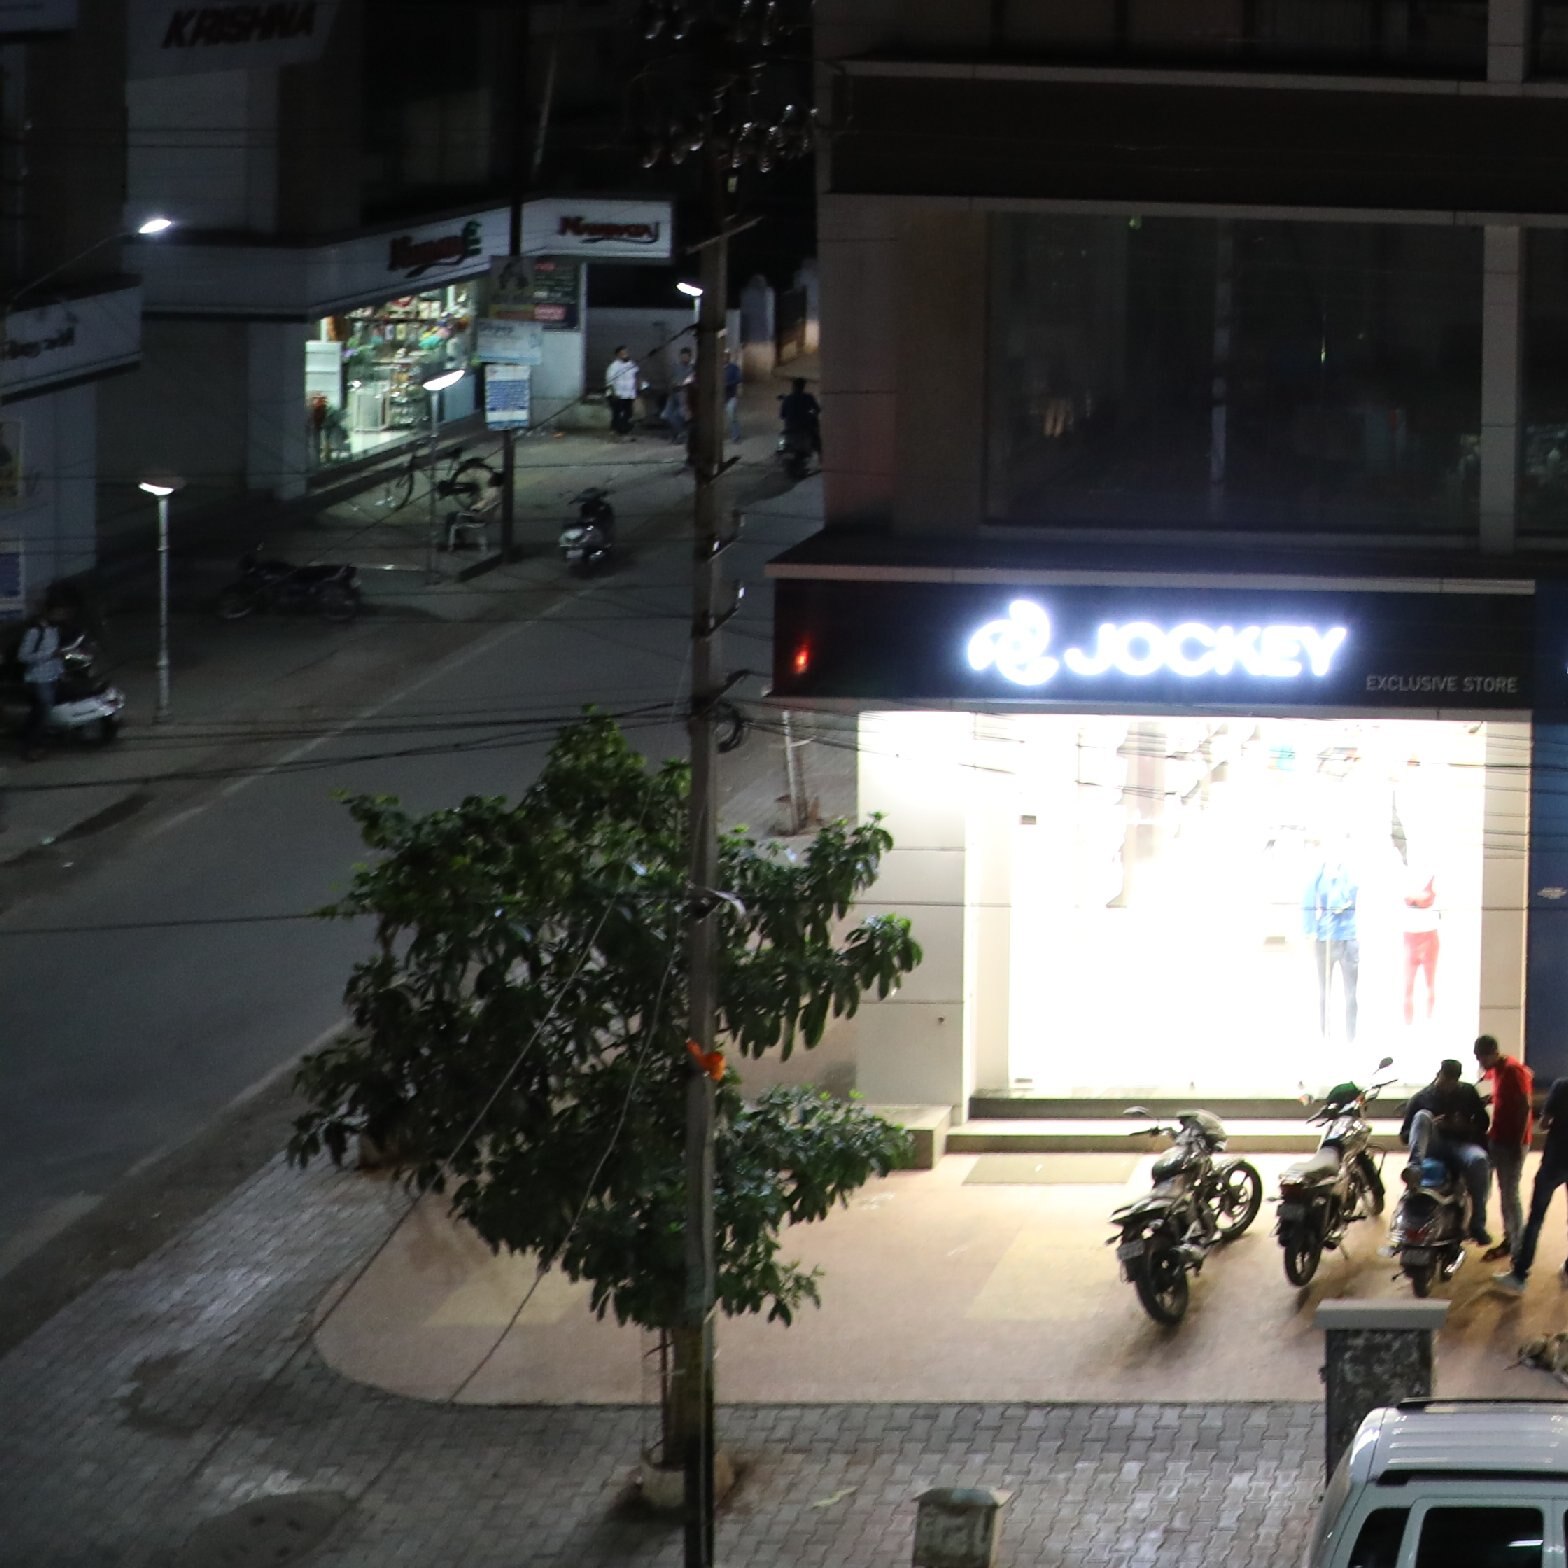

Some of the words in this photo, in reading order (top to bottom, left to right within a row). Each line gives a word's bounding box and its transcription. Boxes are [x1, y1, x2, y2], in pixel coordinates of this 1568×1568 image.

[160, 0, 317, 50] KRISHNA
[1064, 618, 1349, 678] JOCKEY
[1365, 674, 1459, 693] EXCLUSIVE
[1462, 675, 1520, 694] STORE
